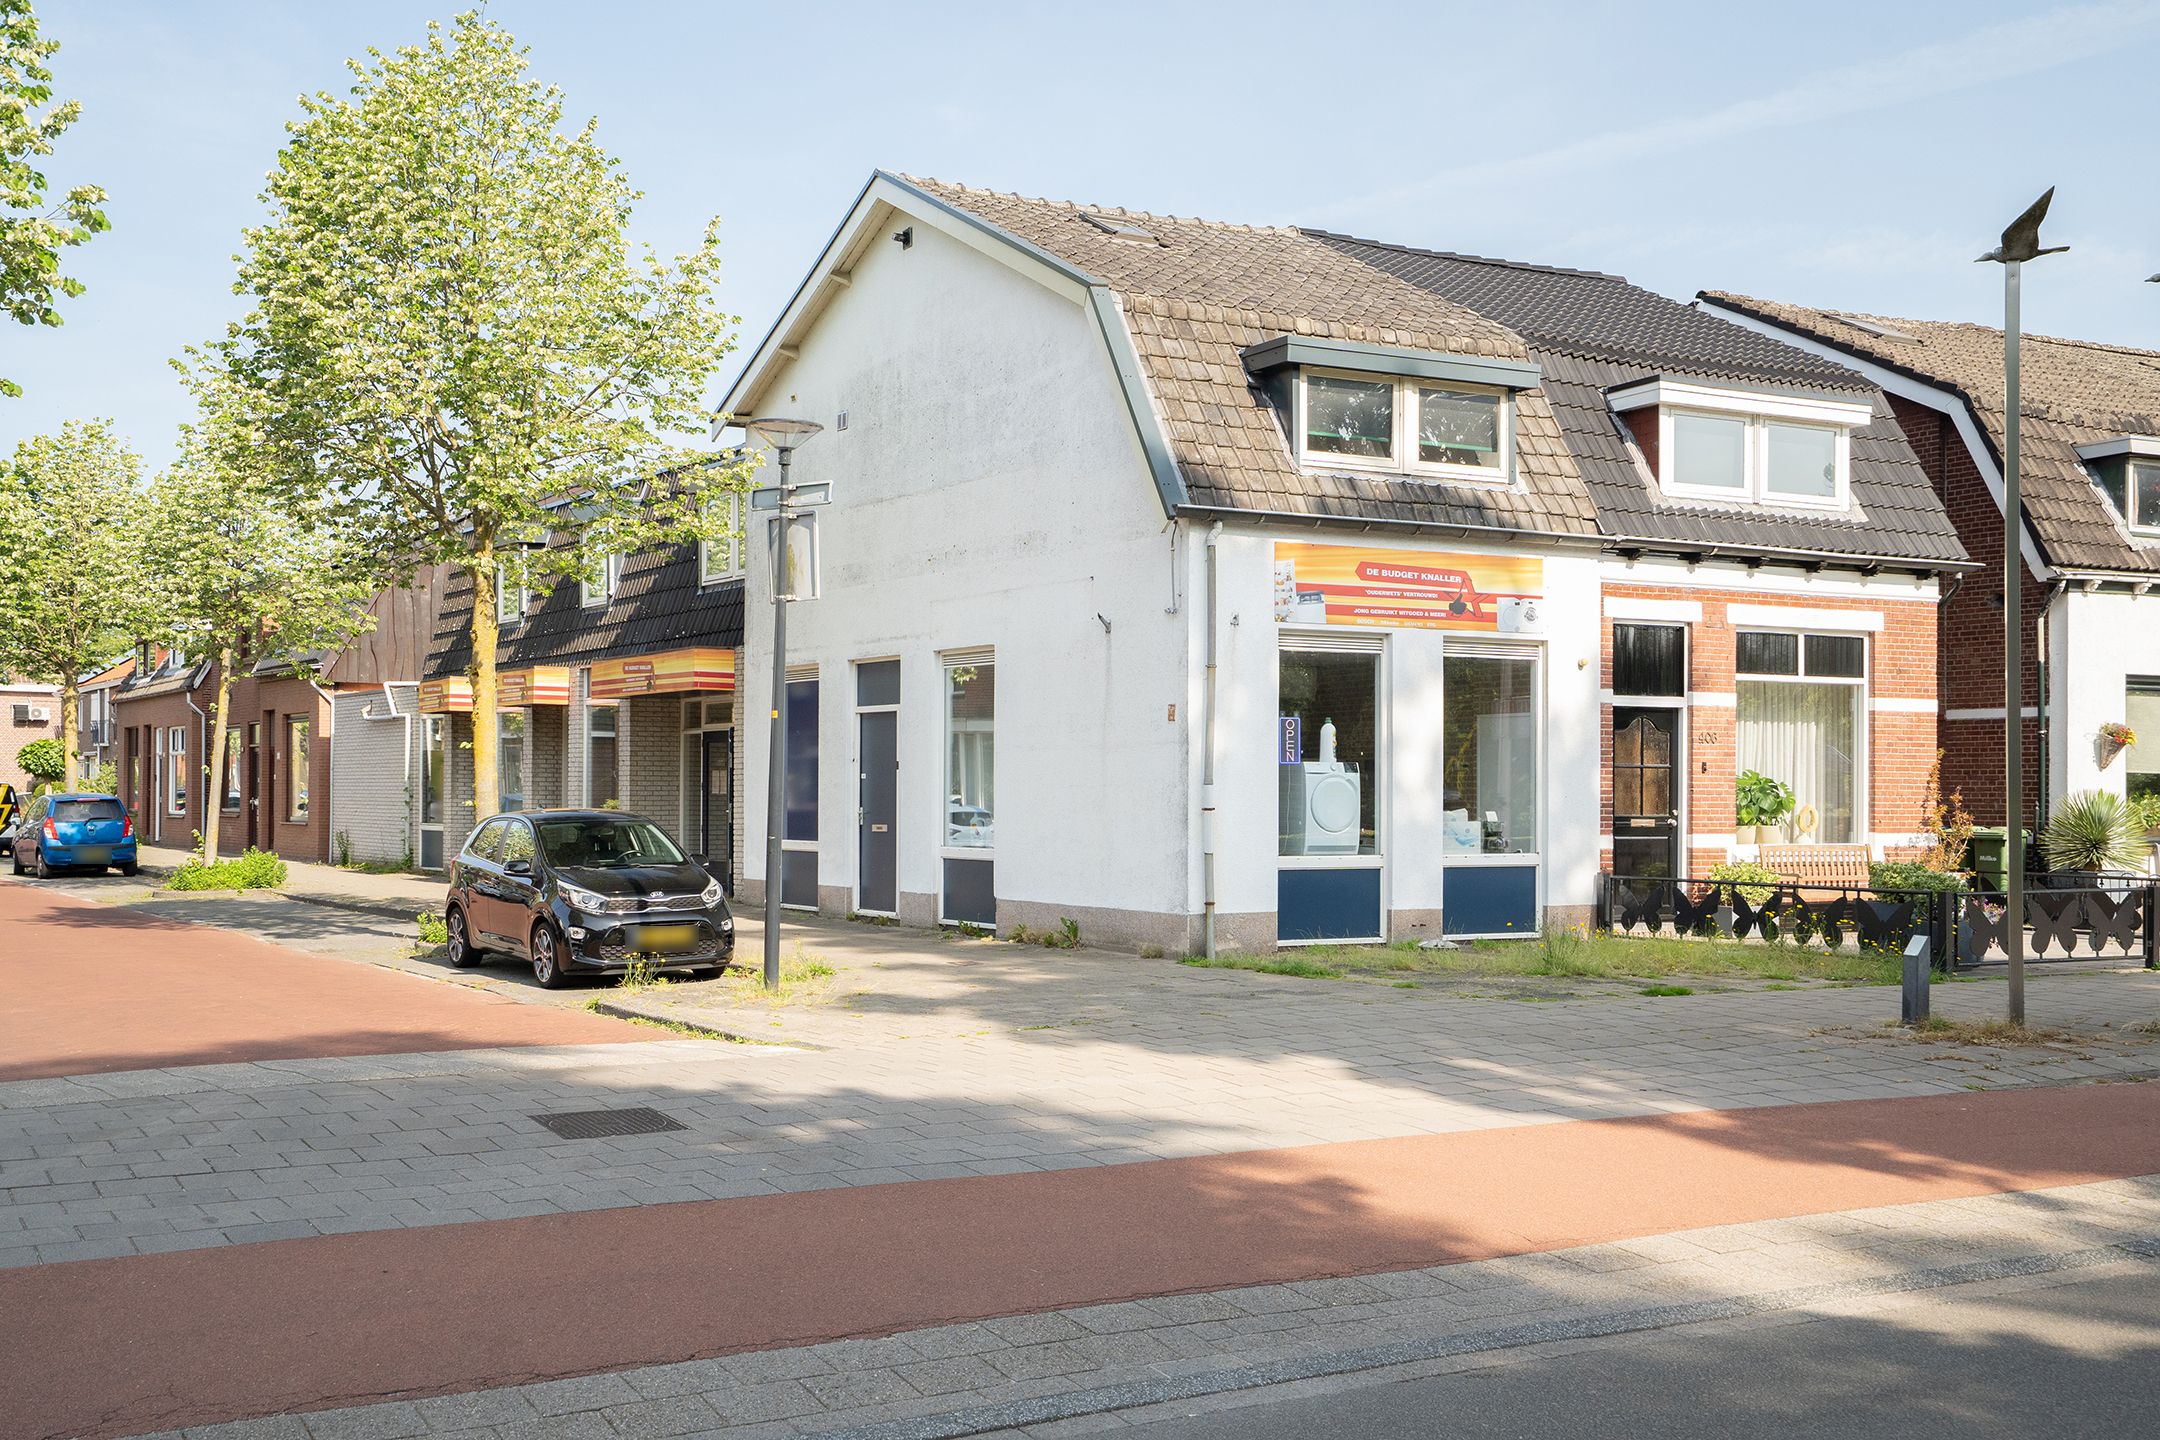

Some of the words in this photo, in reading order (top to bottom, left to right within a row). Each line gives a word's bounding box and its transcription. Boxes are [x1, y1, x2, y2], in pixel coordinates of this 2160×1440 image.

[1366, 568, 1379, 576] DE
[1381, 569, 1420, 579] BUDGET
[1421, 573, 1462, 583] KNALLER
[1285, 719, 1295, 762] OPEN
